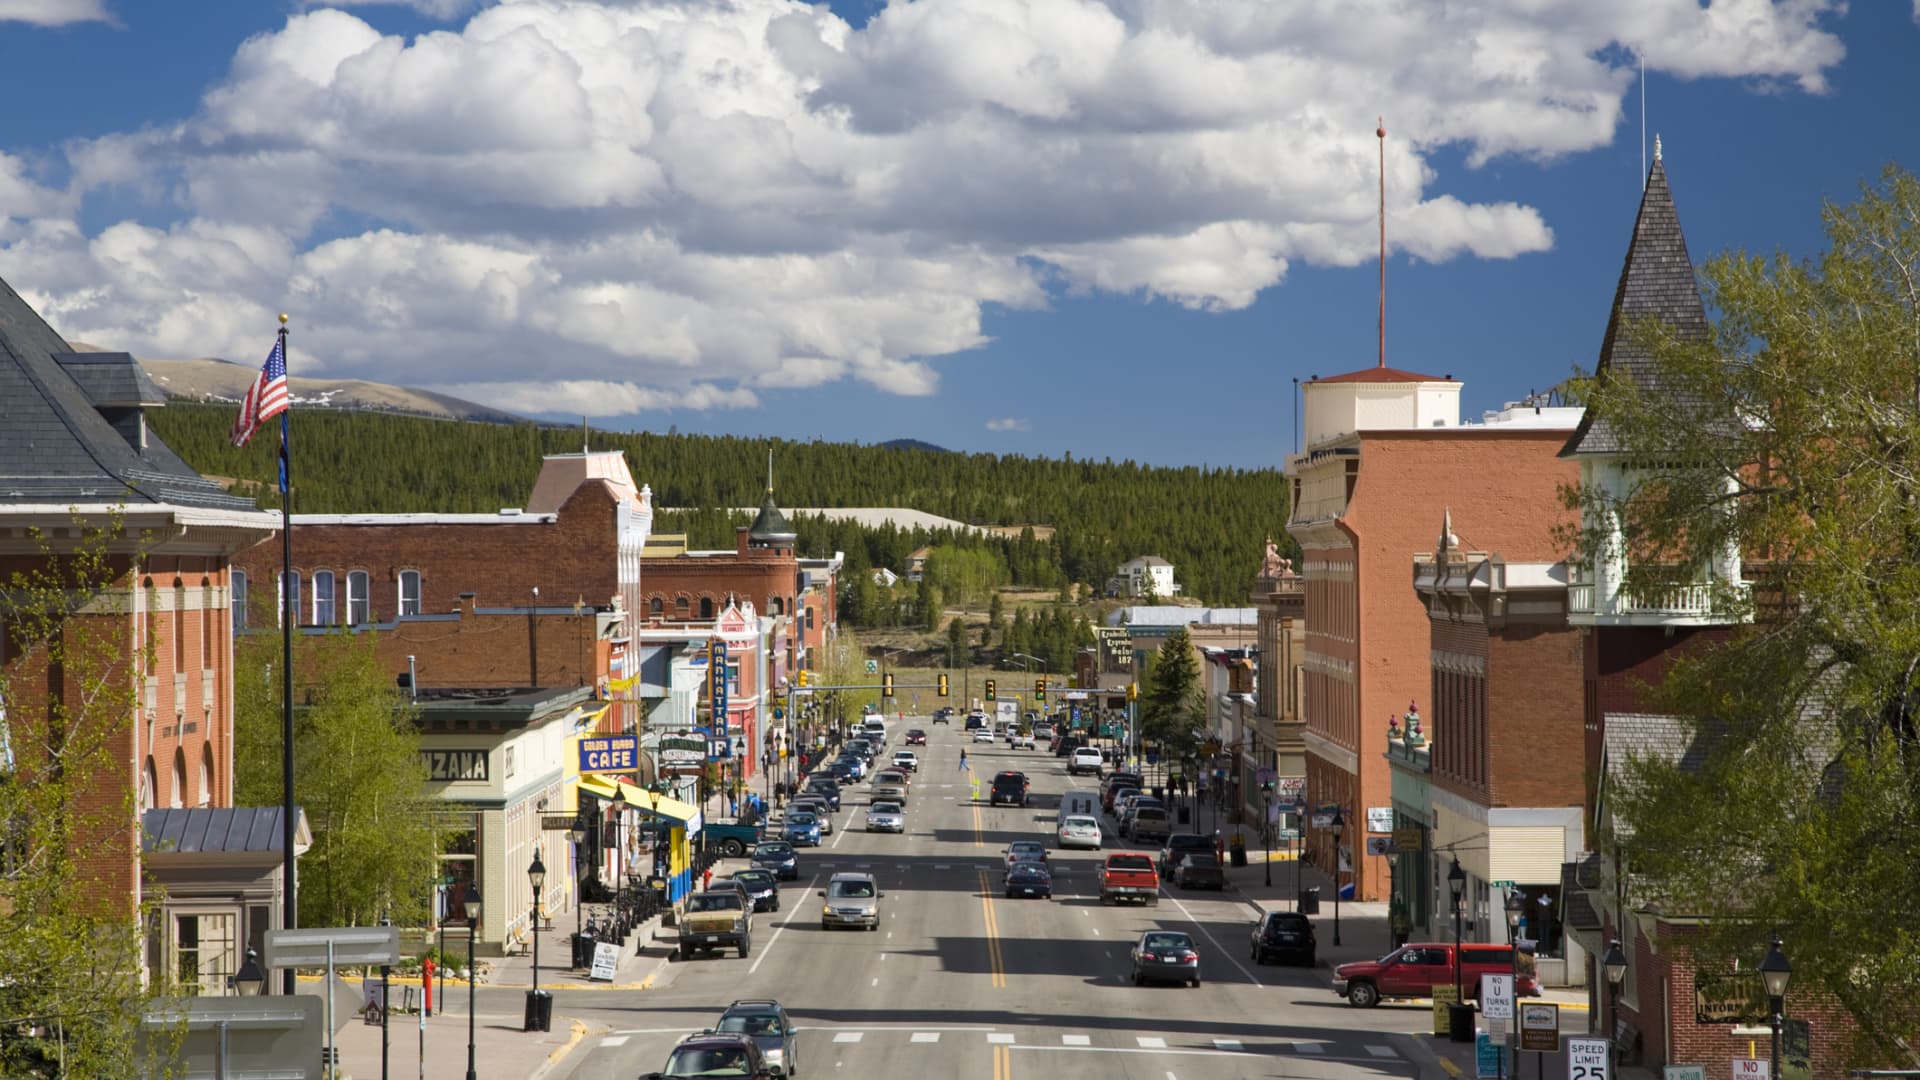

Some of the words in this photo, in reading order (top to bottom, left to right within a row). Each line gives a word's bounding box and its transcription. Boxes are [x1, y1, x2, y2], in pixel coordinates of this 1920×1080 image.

[1118, 656, 1132, 664] 187
[588, 751, 631, 768] CAFE
[420, 752, 486, 779] NZANA
[1492, 976, 1503, 985] NO
[1494, 986, 1501, 996] U
[1486, 998, 1510, 1006] TURNS
[1571, 1044, 1605, 1054] SPEED
[1575, 1056, 1601, 1065] LIMIT
[1743, 1062, 1758, 1072] NO
[1573, 1066, 1605, 1080] 25
